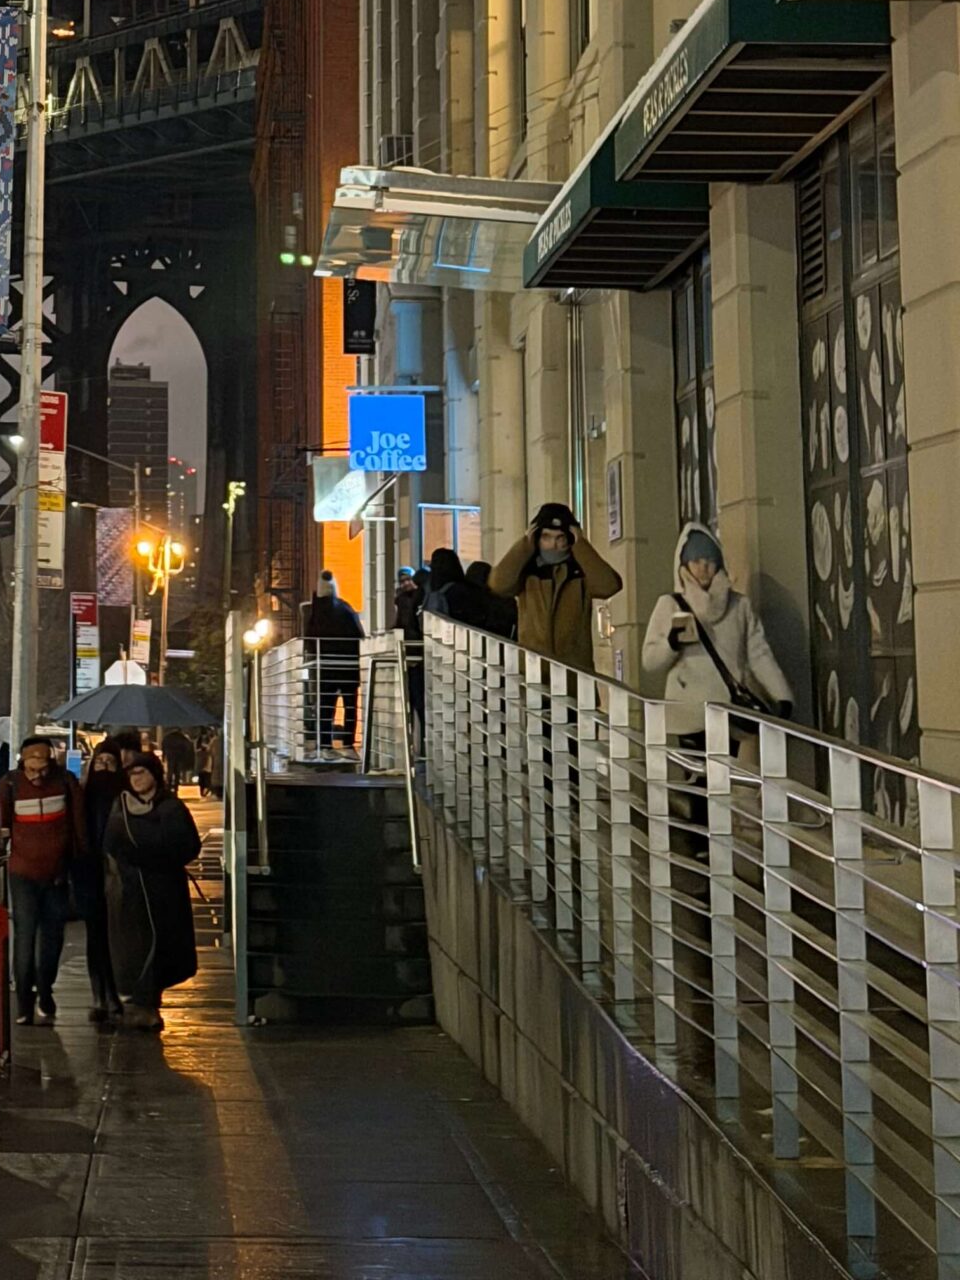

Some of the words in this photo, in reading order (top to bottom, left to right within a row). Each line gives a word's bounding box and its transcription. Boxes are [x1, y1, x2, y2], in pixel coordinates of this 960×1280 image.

[643, 89, 657, 137] PEAS
[663, 47, 689, 111] PICKLES
[365, 431, 411, 454] Joe
[349, 449, 427, 471] Coffee
